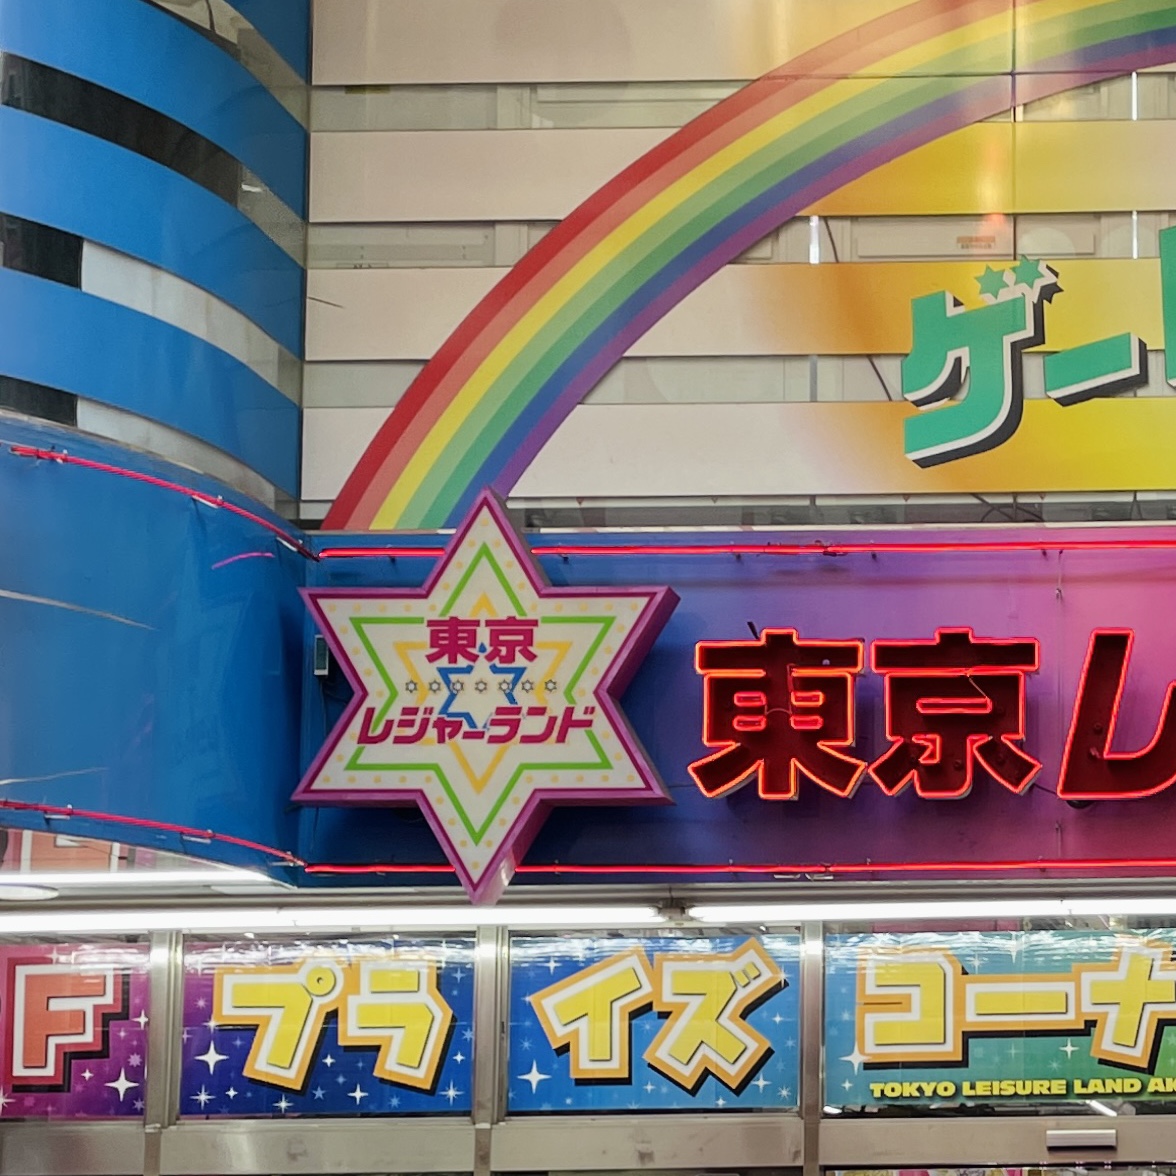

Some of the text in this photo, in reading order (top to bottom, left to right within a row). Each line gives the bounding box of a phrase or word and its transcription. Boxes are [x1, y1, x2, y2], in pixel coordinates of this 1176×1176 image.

[426, 617, 539, 664] 東京
[356, 705, 595, 745] レジャーランド
[870, 1081, 955, 1099] TOKYO
[961, 1079, 1067, 1098] LEISURE
[1073, 1079, 1143, 1096] LAND
